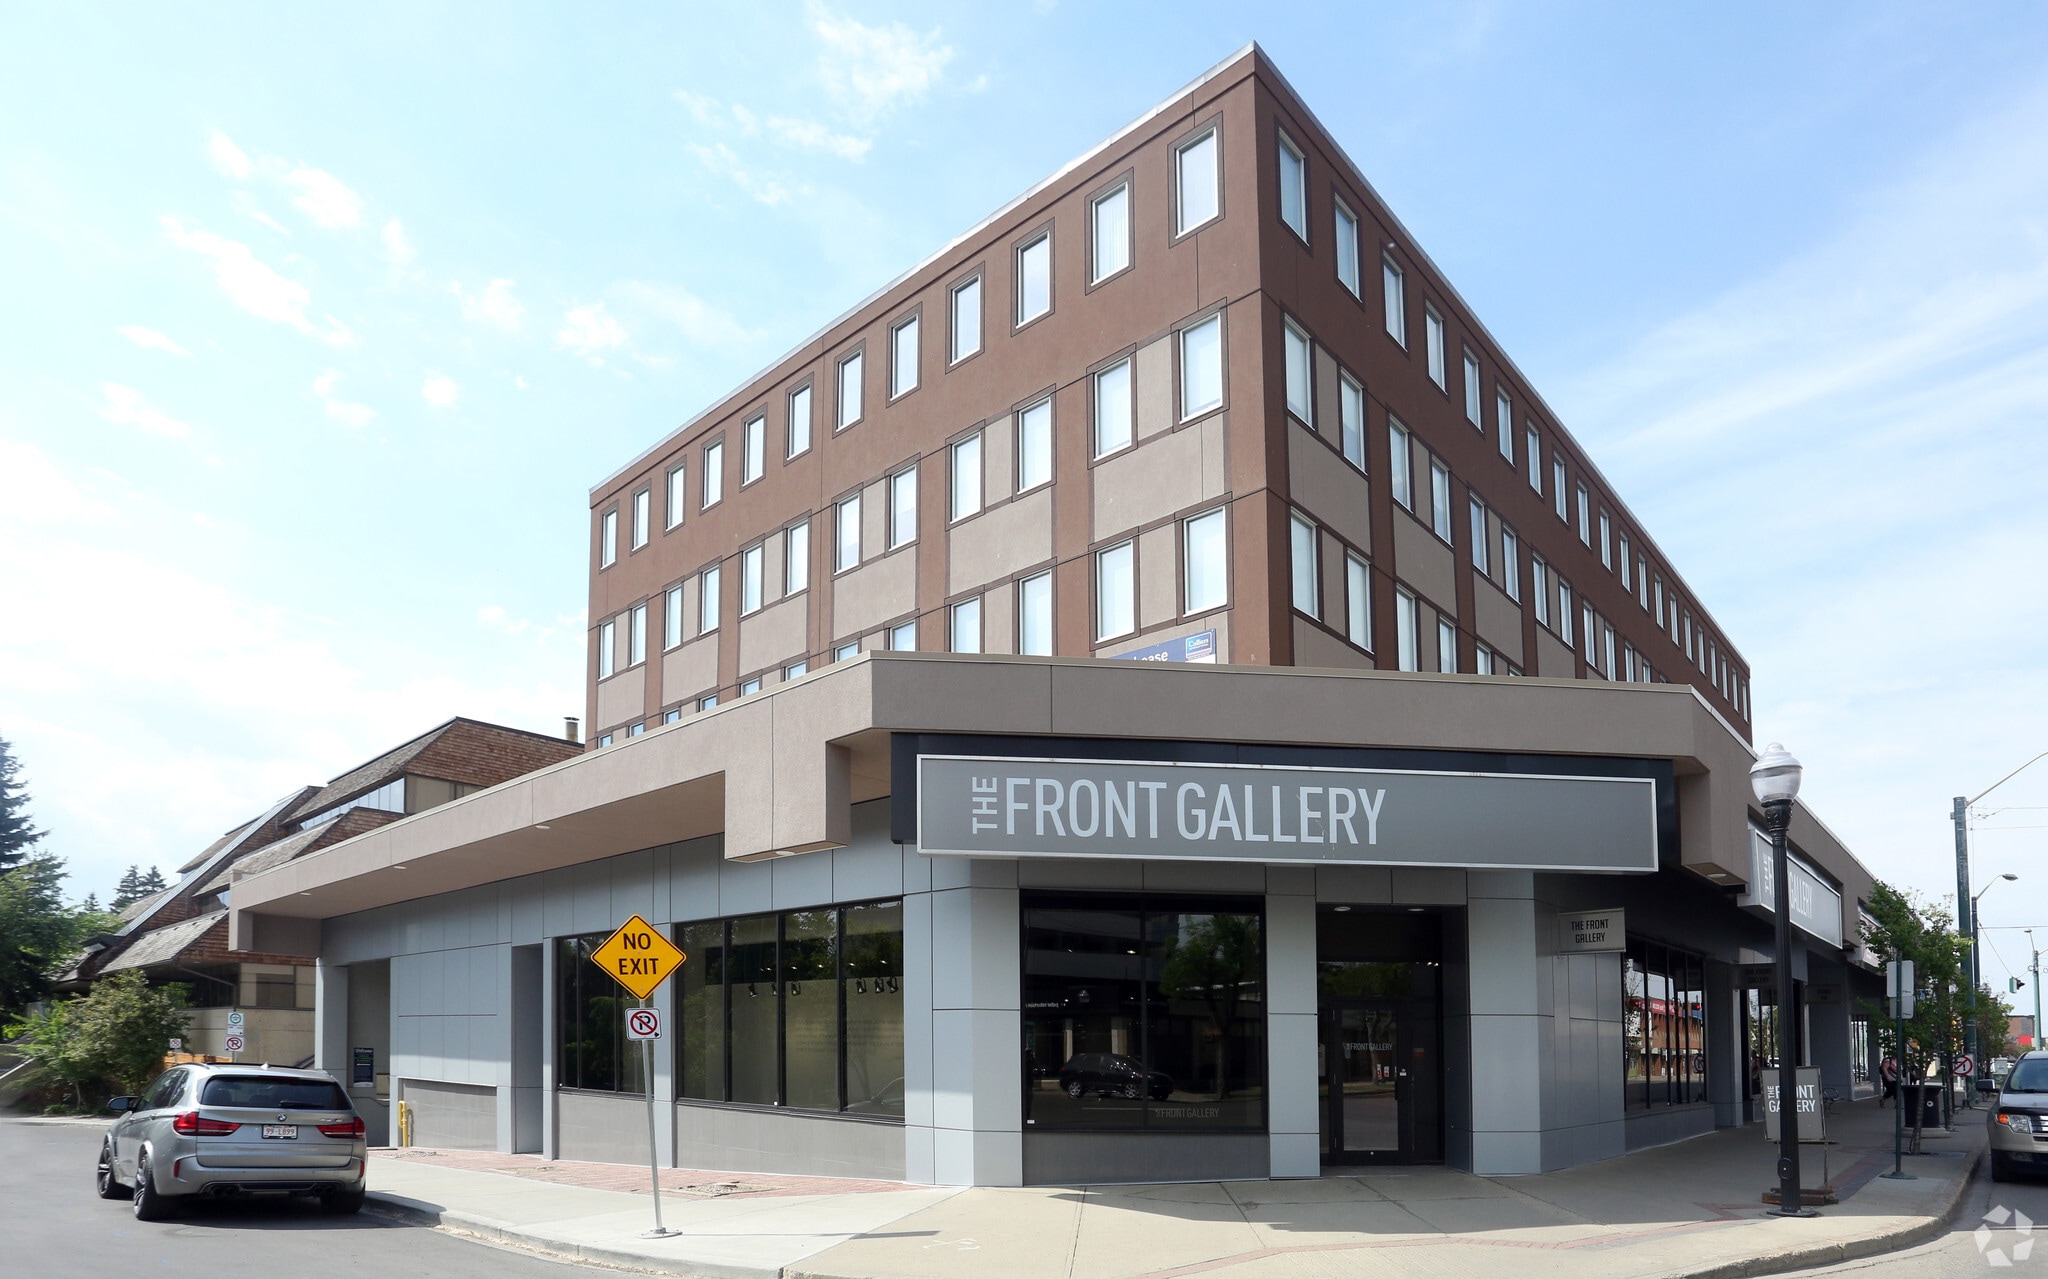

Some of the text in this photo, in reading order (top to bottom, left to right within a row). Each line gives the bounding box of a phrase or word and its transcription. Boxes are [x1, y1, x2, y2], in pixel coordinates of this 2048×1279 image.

[1133, 651, 1168, 662] ase
[972, 776, 1386, 845] THE FRONT GALLERY
[1571, 919, 1609, 931] THE FRONT
[623, 933, 652, 950] NO
[1575, 932, 1606, 943] GALLERY
[618, 958, 659, 975] EXIT
[1351, 1042, 1368, 1051] FRONT
[1369, 1042, 1393, 1051] GALLERY
[1767, 1084, 1815, 1099] THE FNT
[1161, 1107, 1186, 1118] FRONT
[1187, 1107, 1220, 1118] GALLERY
[1768, 1100, 1816, 1113] GAERY
